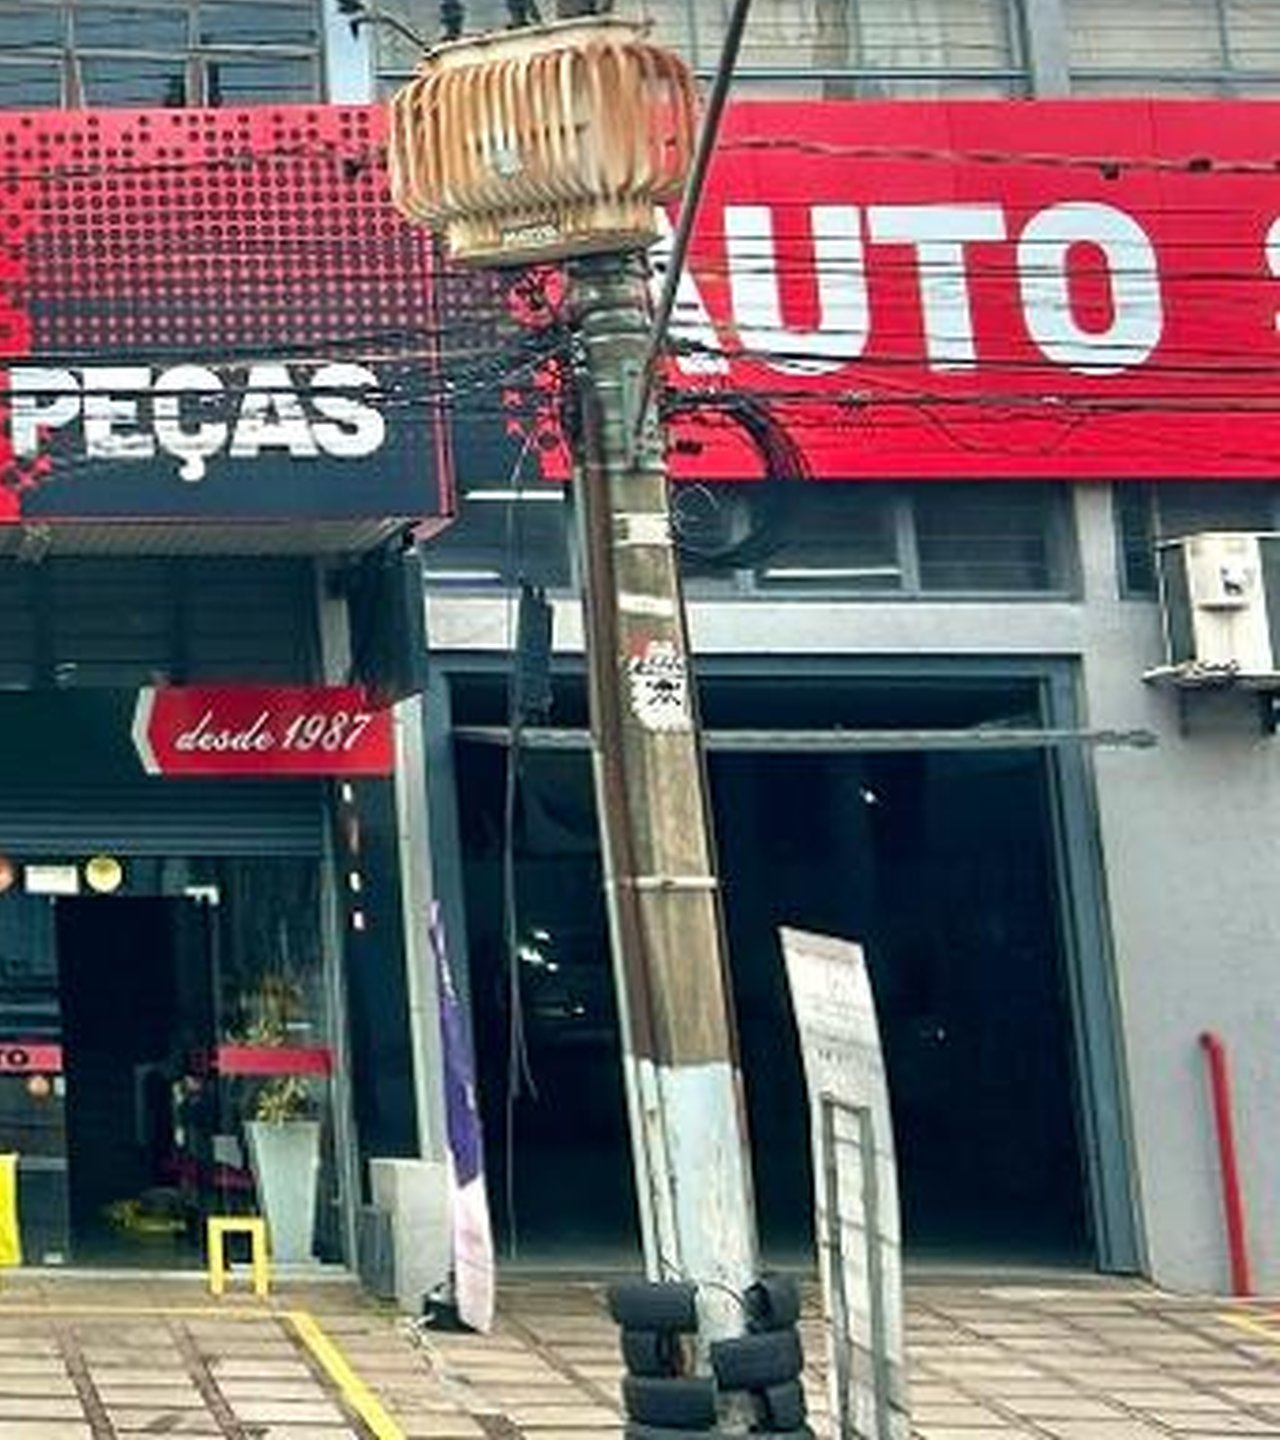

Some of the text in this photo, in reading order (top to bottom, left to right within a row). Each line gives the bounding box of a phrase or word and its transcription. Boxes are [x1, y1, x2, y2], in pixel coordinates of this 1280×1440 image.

[8, 363, 386, 482] PEÇAS
[174, 710, 371, 752] desde 1987
